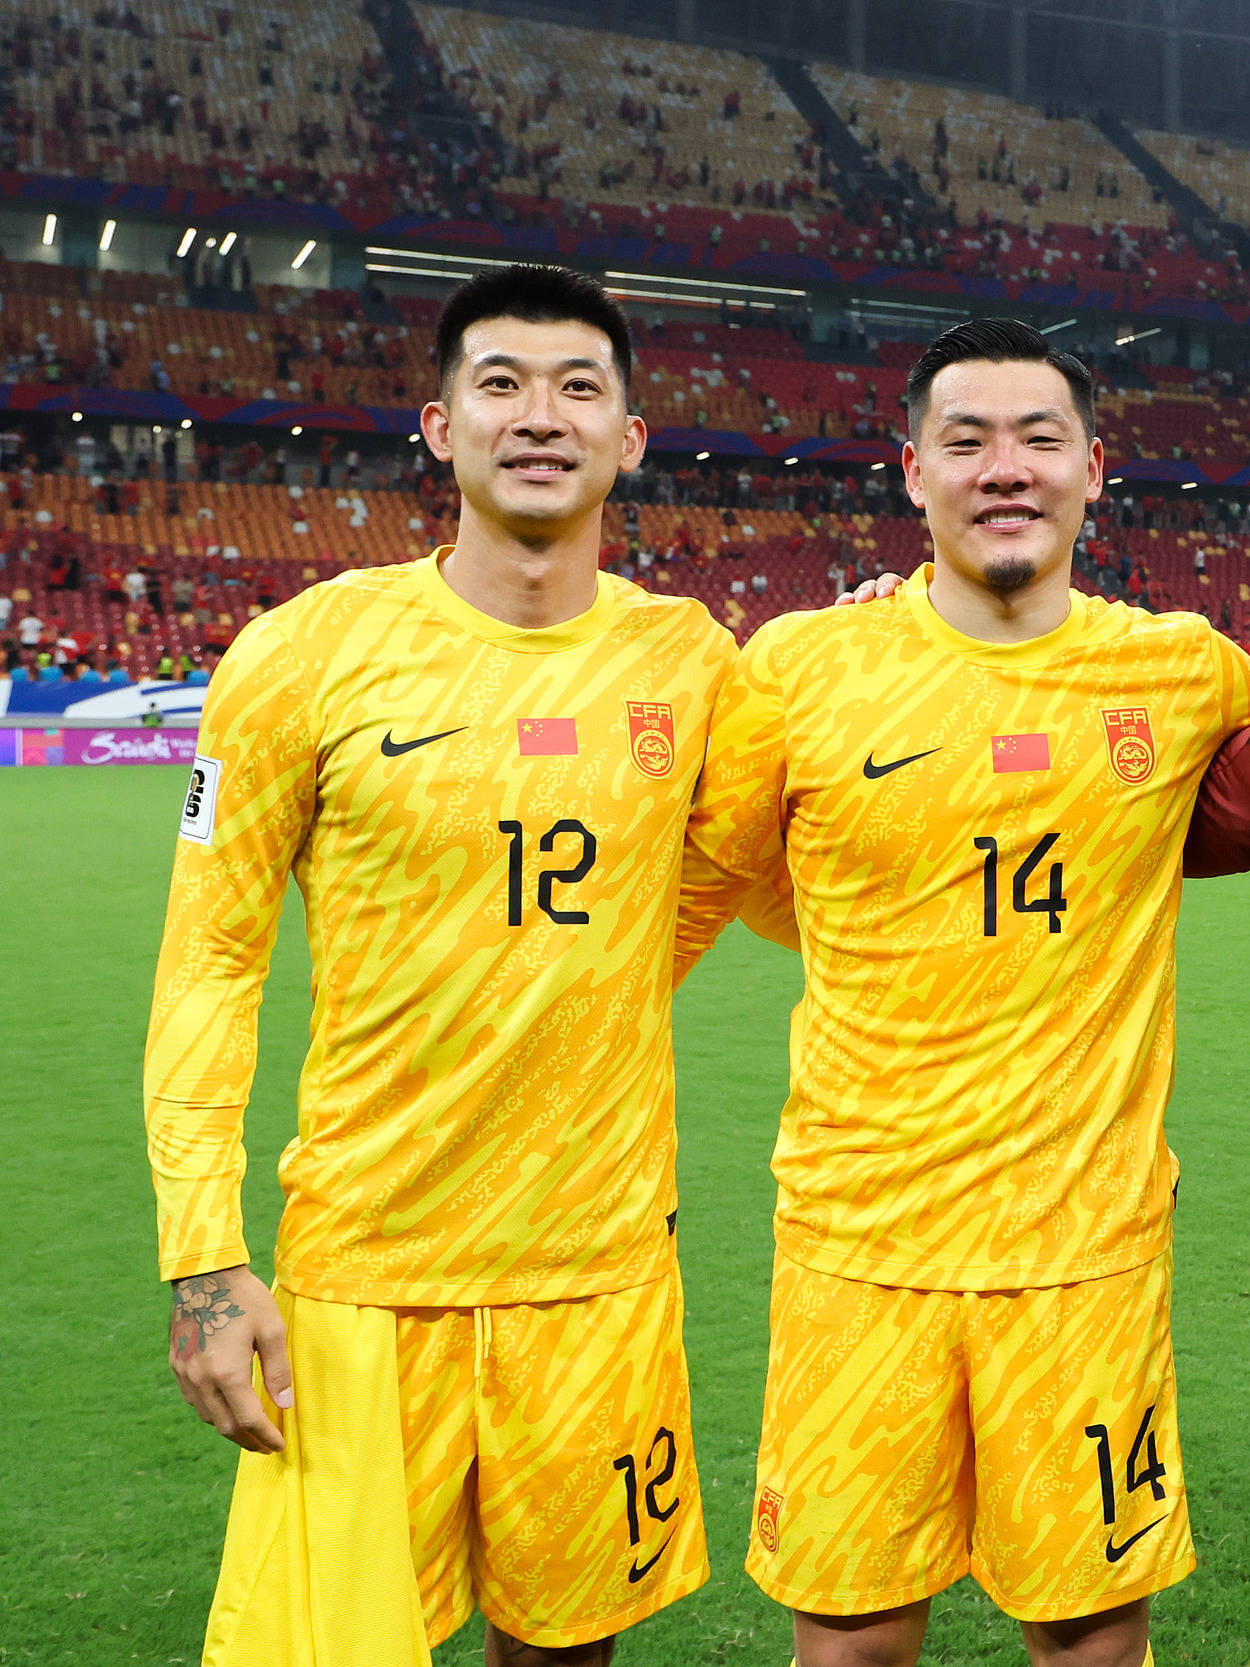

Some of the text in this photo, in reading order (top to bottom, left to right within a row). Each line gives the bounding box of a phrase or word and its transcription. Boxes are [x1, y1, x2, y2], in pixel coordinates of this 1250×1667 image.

[628, 703, 672, 720] CFA
[1104, 710, 1148, 726] CFA
[498, 818, 597, 927] 12
[973, 832, 1067, 937] 14
[612, 1426, 680, 1547] 12
[761, 1487, 782, 1510] CFA
[1084, 1403, 1167, 1526] 14
